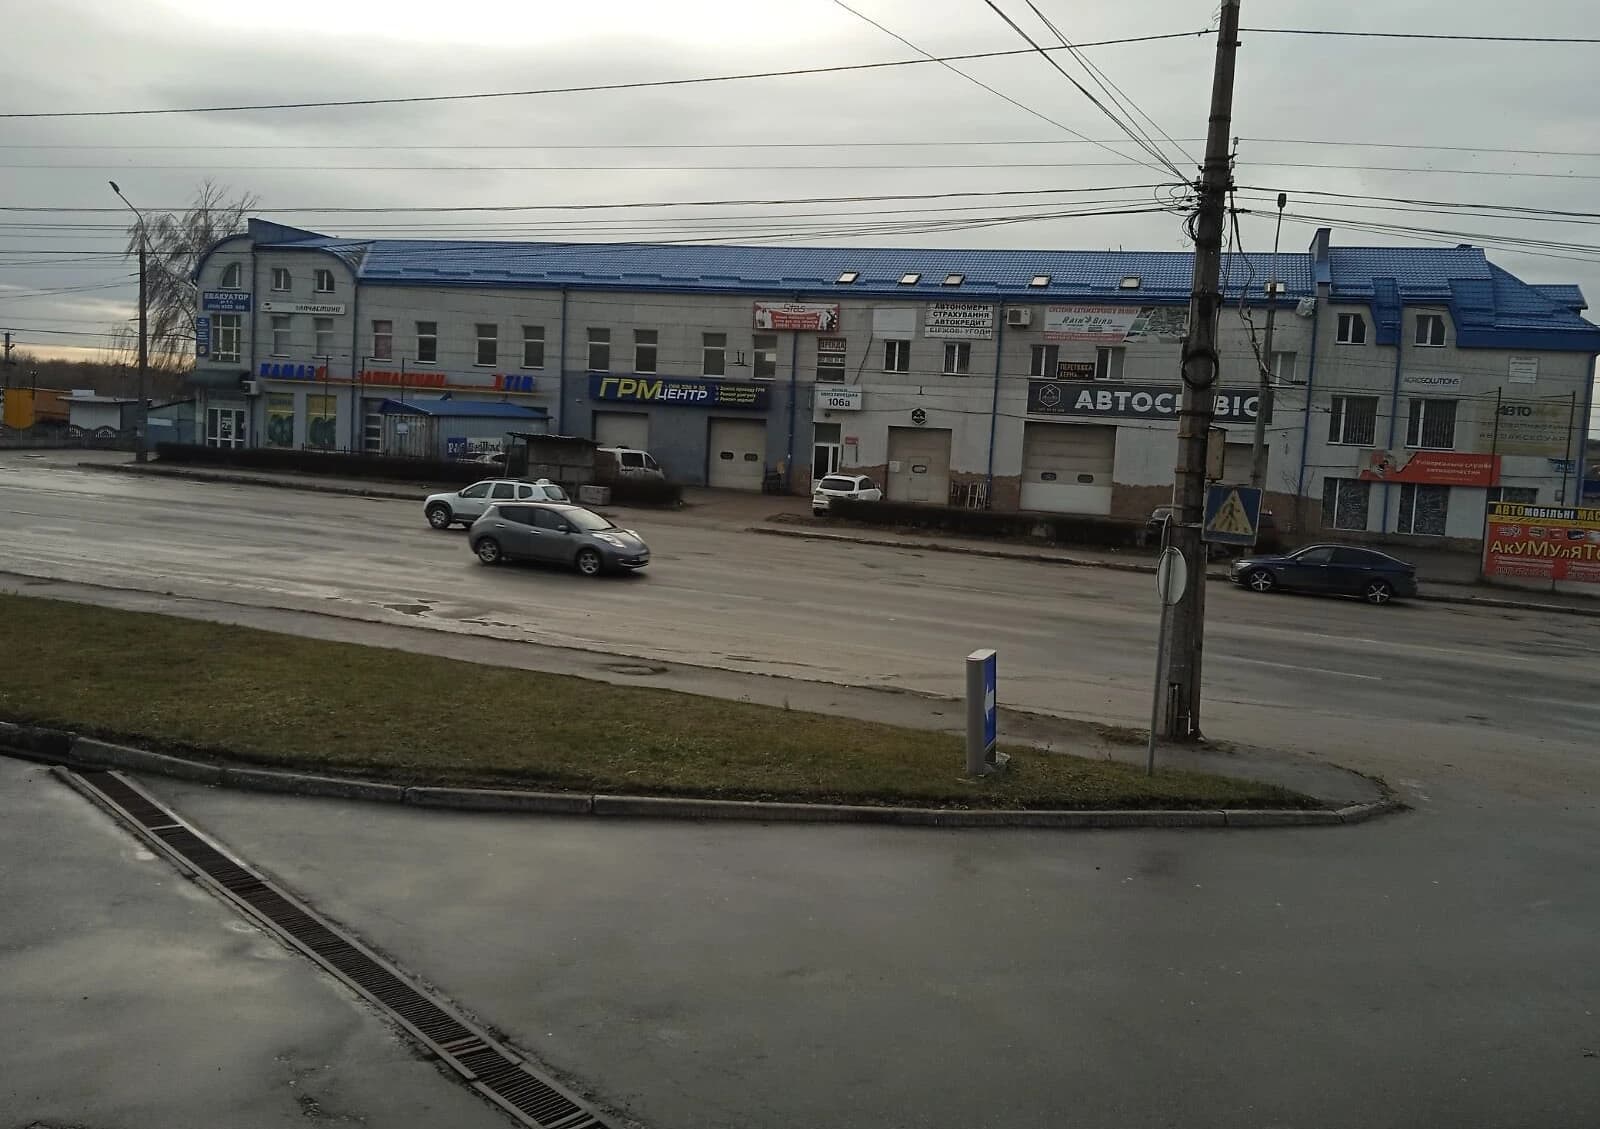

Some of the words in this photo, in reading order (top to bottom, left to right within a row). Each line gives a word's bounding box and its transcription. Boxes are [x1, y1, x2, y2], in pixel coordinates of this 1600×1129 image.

[934, 303, 989, 311] АВТОНОМЕРИ
[934, 319, 987, 327] АВТОКРЕДИТ
[600, 378, 663, 400] ГРМ
[657, 389, 708, 401] ЦЕНТР
[829, 398, 851, 407] 106а
[1074, 390, 1260, 417] АВТОСВІС
[1496, 504, 1574, 520] АВТОМОБІЛЬНІ
